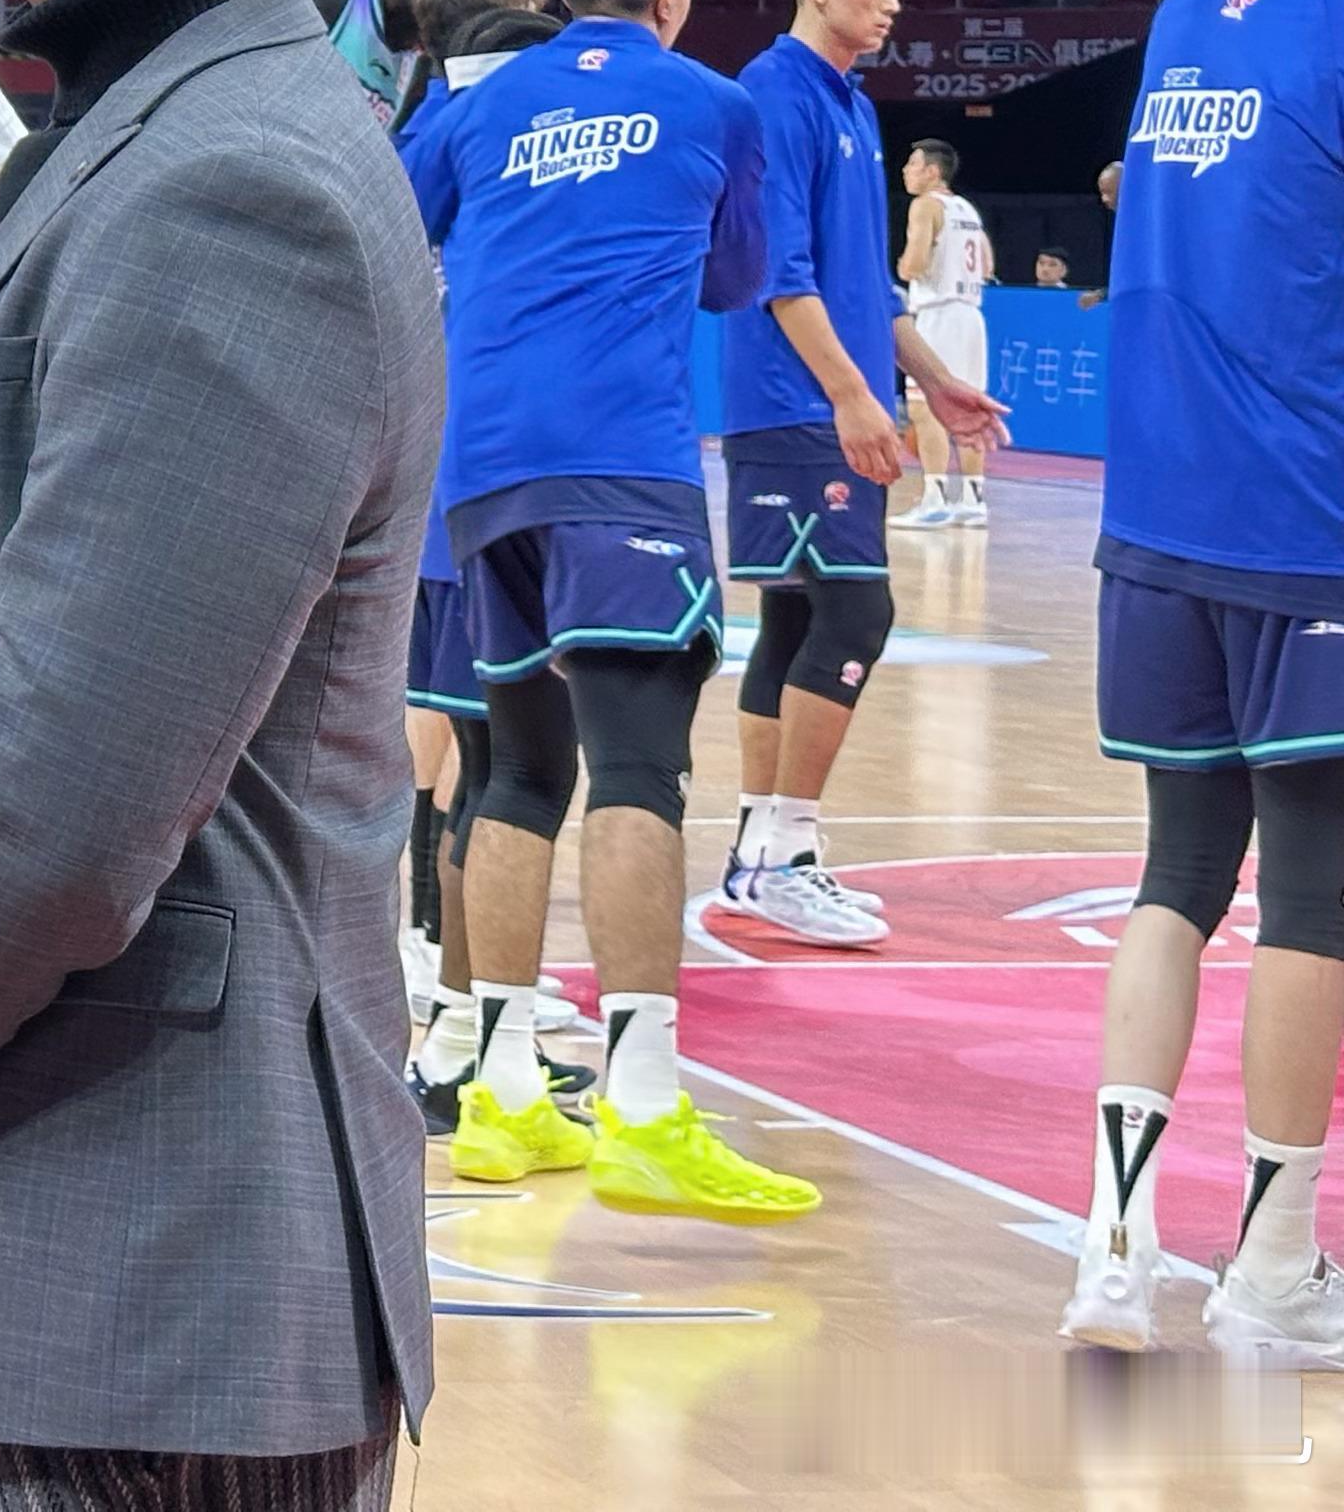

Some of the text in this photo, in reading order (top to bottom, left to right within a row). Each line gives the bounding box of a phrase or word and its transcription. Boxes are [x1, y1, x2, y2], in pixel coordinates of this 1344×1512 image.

[913, 72, 1050, 99] 2025-20
[1145, 94, 1257, 135] NINGBO
[513, 118, 653, 169] NINGBO
[536, 147, 616, 181] ROCKETS
